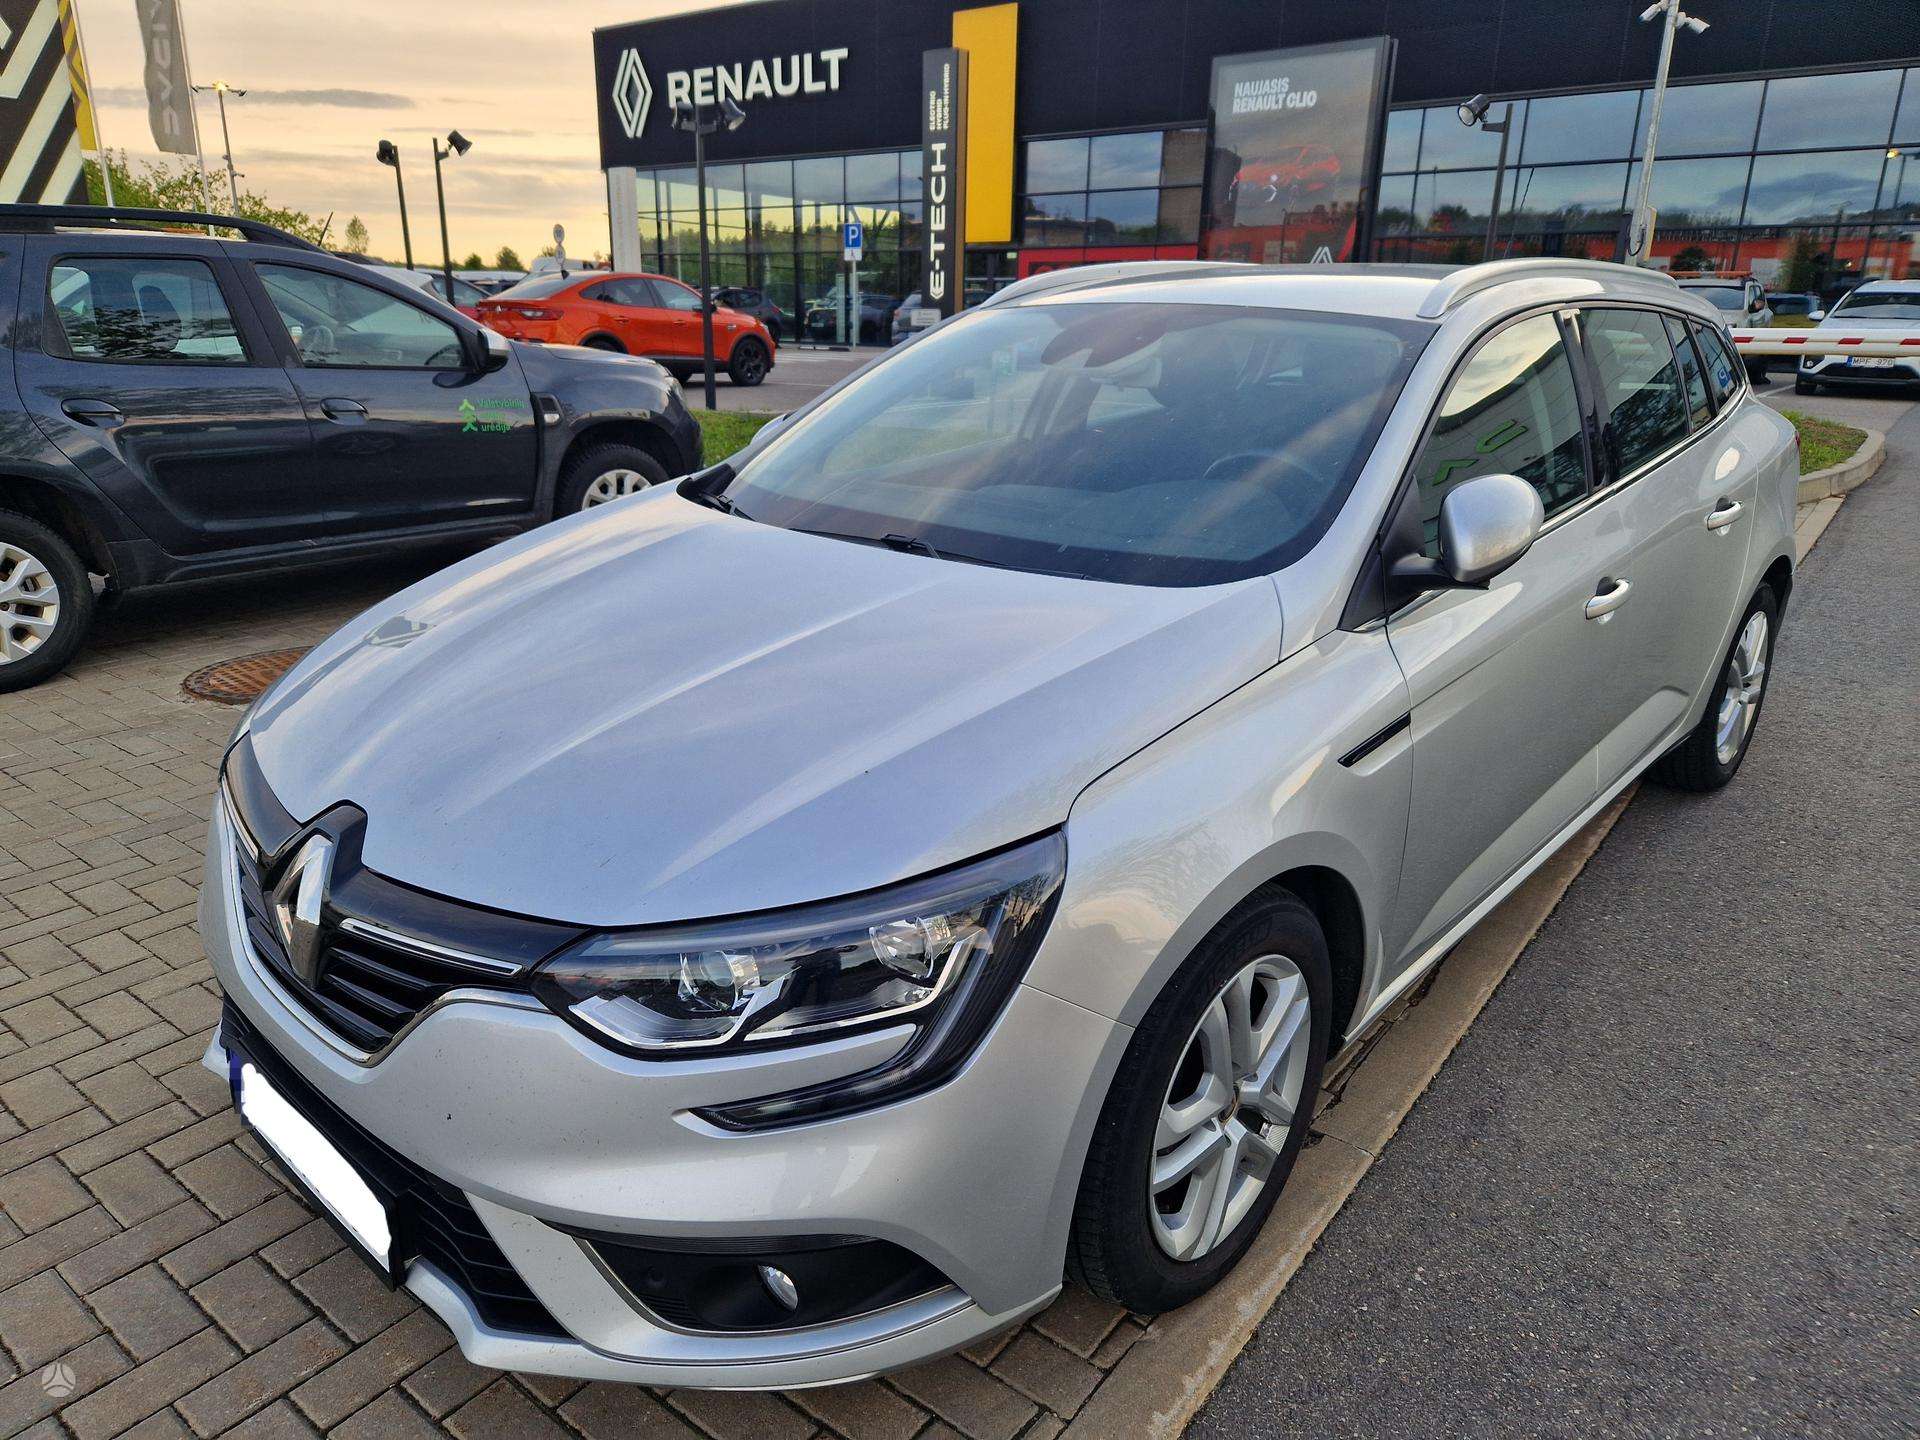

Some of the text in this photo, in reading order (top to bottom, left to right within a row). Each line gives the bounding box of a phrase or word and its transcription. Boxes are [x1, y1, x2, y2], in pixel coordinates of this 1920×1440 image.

[667, 48, 849, 109] RENAULT
[1234, 77, 1289, 97] NAUJASIS
[1232, 90, 1317, 113] RENAULT CLIO
[930, 142, 947, 299] E-TECH
[848, 226, 859, 246] P
